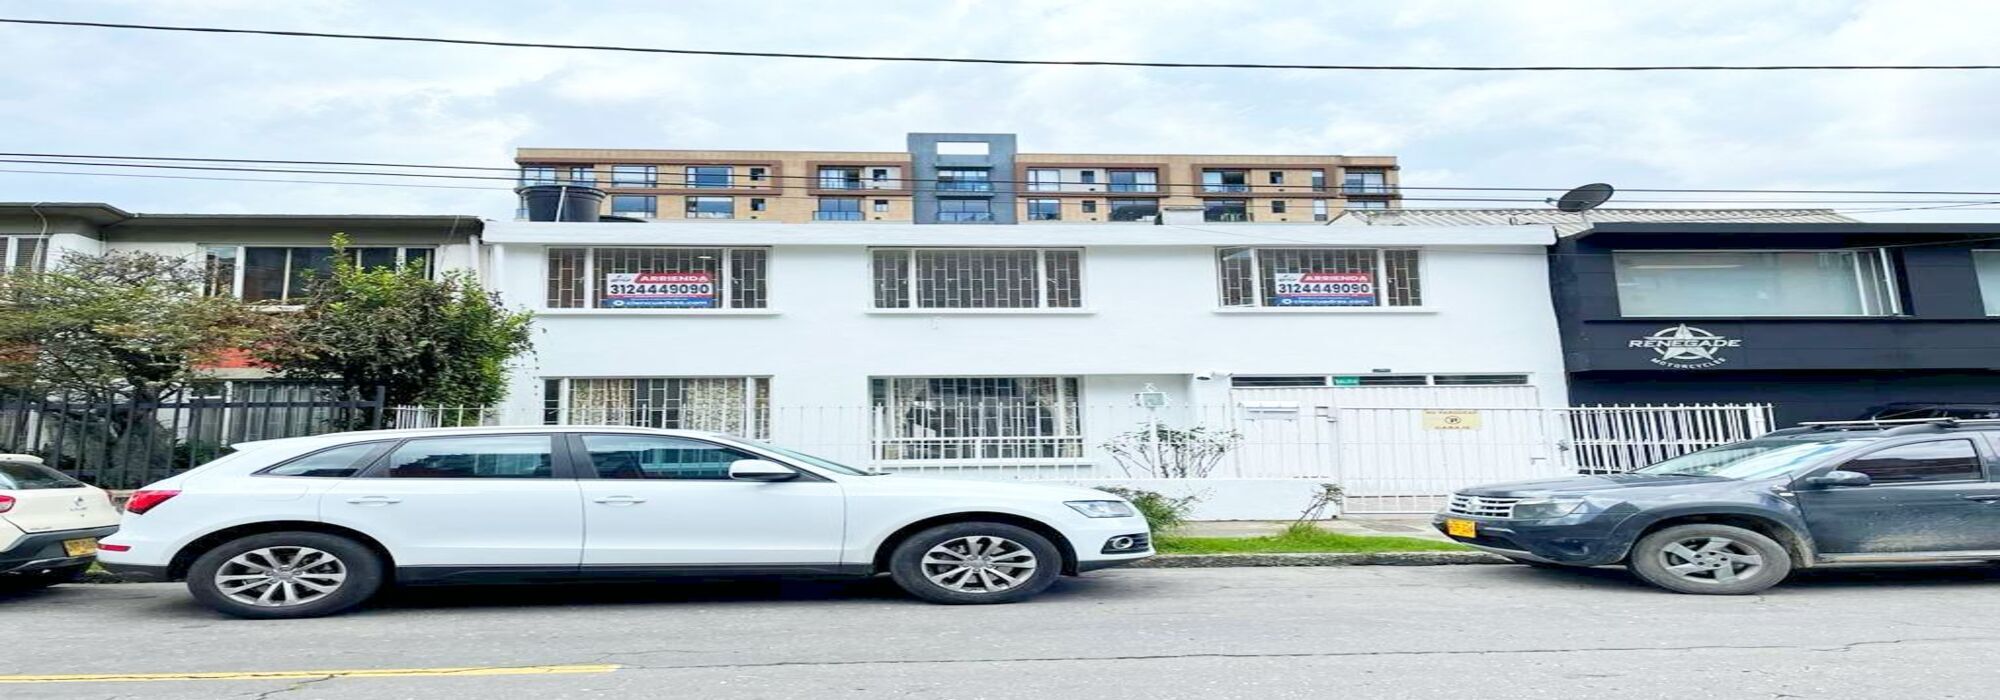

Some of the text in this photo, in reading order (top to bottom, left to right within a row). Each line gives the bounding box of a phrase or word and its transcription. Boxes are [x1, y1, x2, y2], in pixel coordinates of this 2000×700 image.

[610, 284, 710, 294] 3124449090
[1278, 283, 1370, 293] 3124449090
[1628, 339, 1742, 348] RENEGADE
[1650, 357, 1726, 369] MOTORCYCLES
